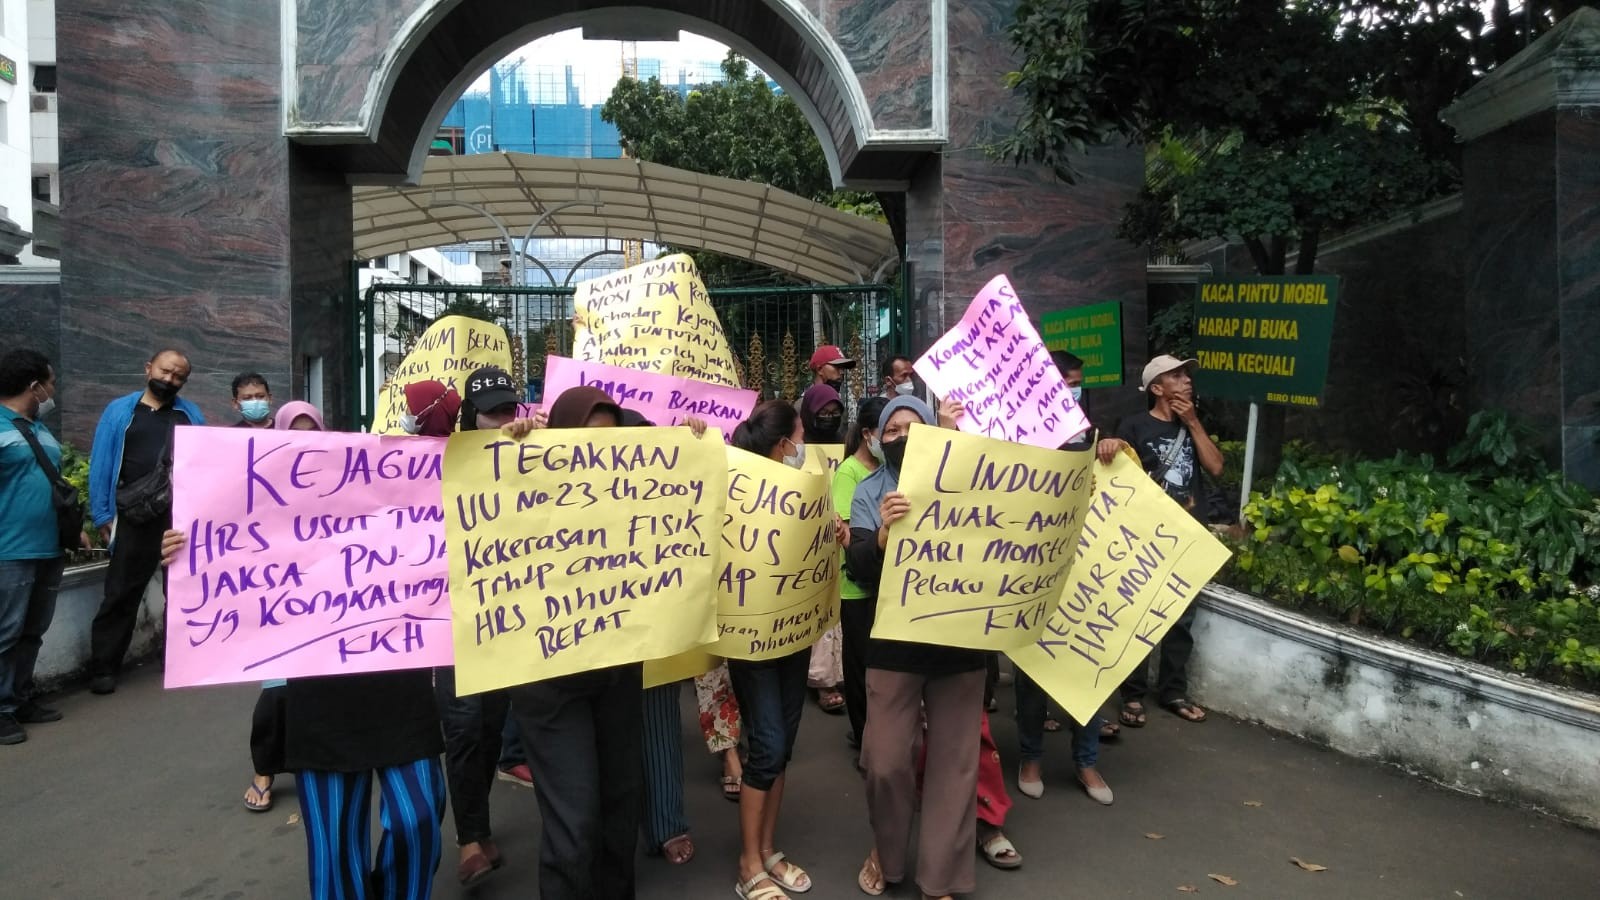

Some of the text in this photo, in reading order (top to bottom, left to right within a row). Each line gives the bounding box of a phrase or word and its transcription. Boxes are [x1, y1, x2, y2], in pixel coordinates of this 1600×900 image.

[590, 274, 632, 295] KAMI
[641, 281, 679, 300] TDK
[1201, 283, 1328, 305] KACA PINTU MOBIL
[466, 328, 506, 353] BERAT
[1198, 317, 1298, 340] HARAP DI BUKA
[1197, 350, 1295, 377] TANPA KECUALI
[668, 390, 742, 420] BIARKAN
[1266, 392, 1288, 403] BIRO
[247, 436, 442, 515] KEJAGUN
[484, 441, 680, 482] TEGAKKAN
[456, 492, 501, 532] UU
[189, 518, 270, 577] HRS
[294, 513, 378, 542] USUT
[894, 538, 963, 567] DARI
[180, 562, 308, 613] JAKSA
[1036, 524, 1141, 660] KELUARGA
[1069, 523, 1179, 666] HARMONIS
[475, 603, 526, 646] HRS
[984, 601, 1047, 635] KKH
[1135, 572, 1192, 649] KKH
[336, 621, 425, 664] KKH
[535, 609, 631, 660] BERAT
